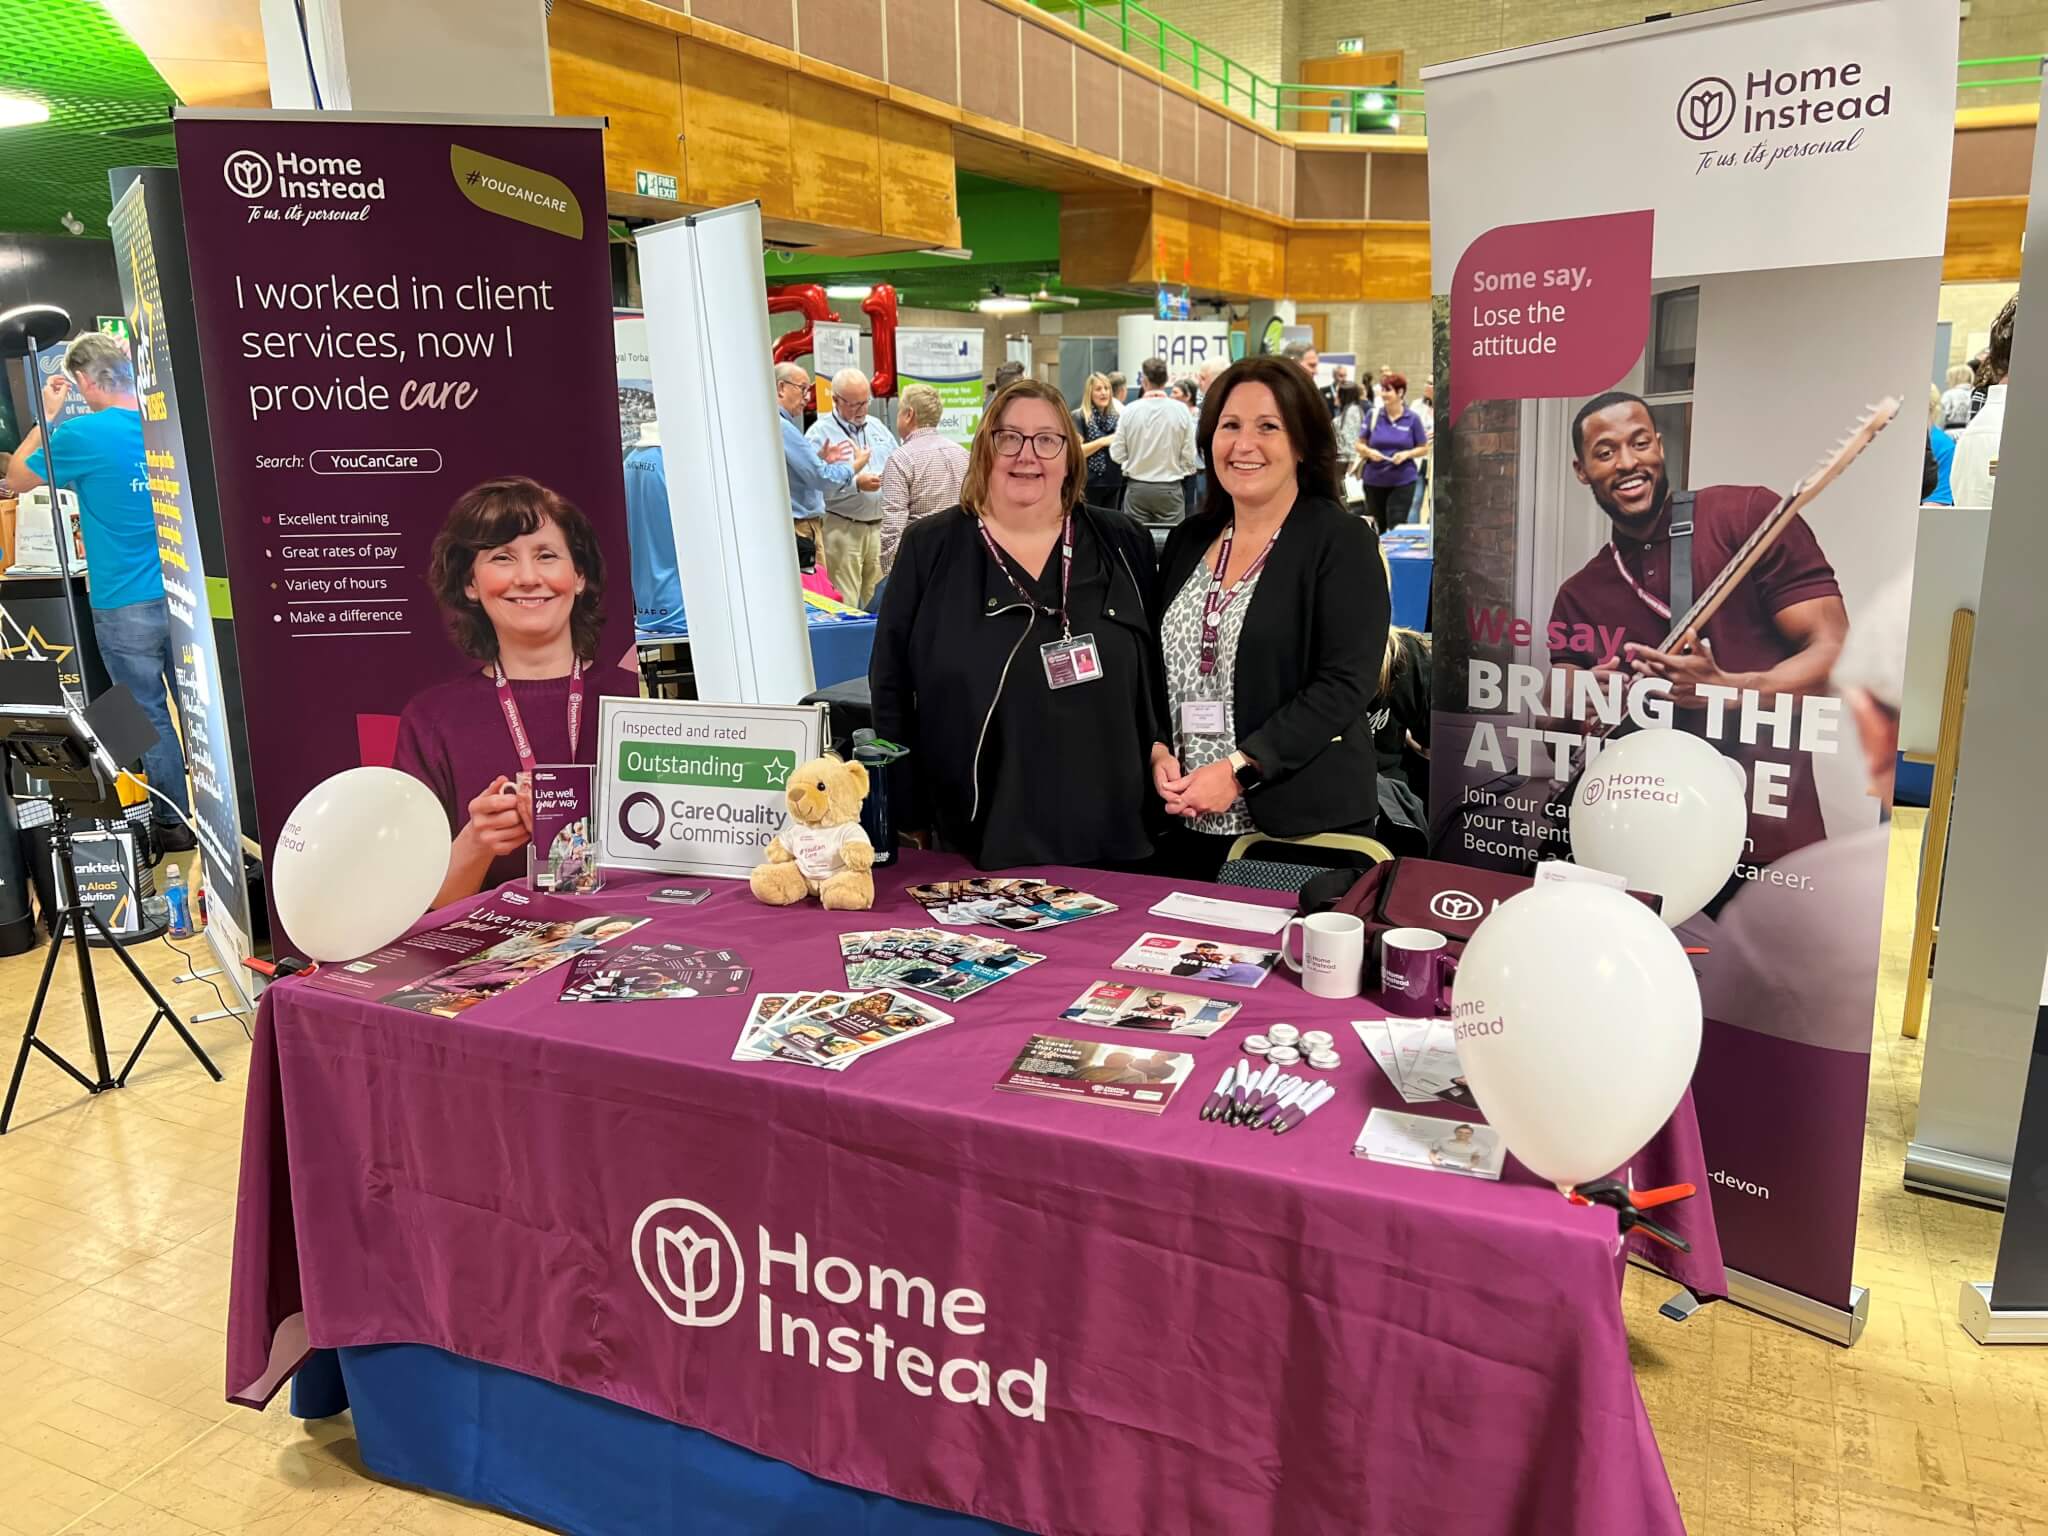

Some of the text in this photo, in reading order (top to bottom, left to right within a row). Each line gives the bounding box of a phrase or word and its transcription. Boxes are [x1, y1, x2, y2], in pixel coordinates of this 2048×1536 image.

[1746, 63, 1861, 100] Home
[1744, 85, 1891, 134] Instead
[1696, 150, 1718, 175] To
[1765, 127, 1865, 170] personal
[276, 152, 361, 175] Home
[280, 176, 386, 199] Instead
[464, 170, 568, 213] #YOUCANCARE
[658, 176, 675, 188] FIRE
[658, 188, 677, 199] EXIT
[248, 205, 264, 223] To
[302, 204, 370, 226] personal
[1473, 266, 1592, 293] Some say,
[235, 274, 554, 311] I worked in client
[1473, 301, 1565, 327] Lose the
[241, 325, 513, 363] services, now I
[1472, 331, 1557, 356] attitude
[249, 376, 478, 421] provide care
[255, 454, 418, 469] Search: YouCanCare
[278, 512, 389, 527] Excellent training
[282, 544, 398, 559] Great rates of pay
[285, 577, 387, 593] Variety of hours
[289, 609, 403, 623] Make a difference
[1467, 607, 1532, 647] We
[1468, 658, 1841, 754] BRING THE
[622, 721, 746, 740] Inspected and rated
[627, 751, 743, 783] Outstanding
[1608, 773, 1665, 787] Home
[535, 789, 554, 798] Live
[559, 800, 578, 810] way
[1462, 785, 1497, 806] Join
[1504, 796, 1538, 813] our
[1607, 787, 1679, 804] Instead
[1463, 811, 1505, 832] your
[670, 821, 776, 847] Commissio
[1464, 832, 1539, 862] Become
[79, 892, 115, 902] olution
[469, 907, 511, 923] Live
[758, 1223, 987, 1336] Home
[759, 1293, 1048, 1423] Instead
